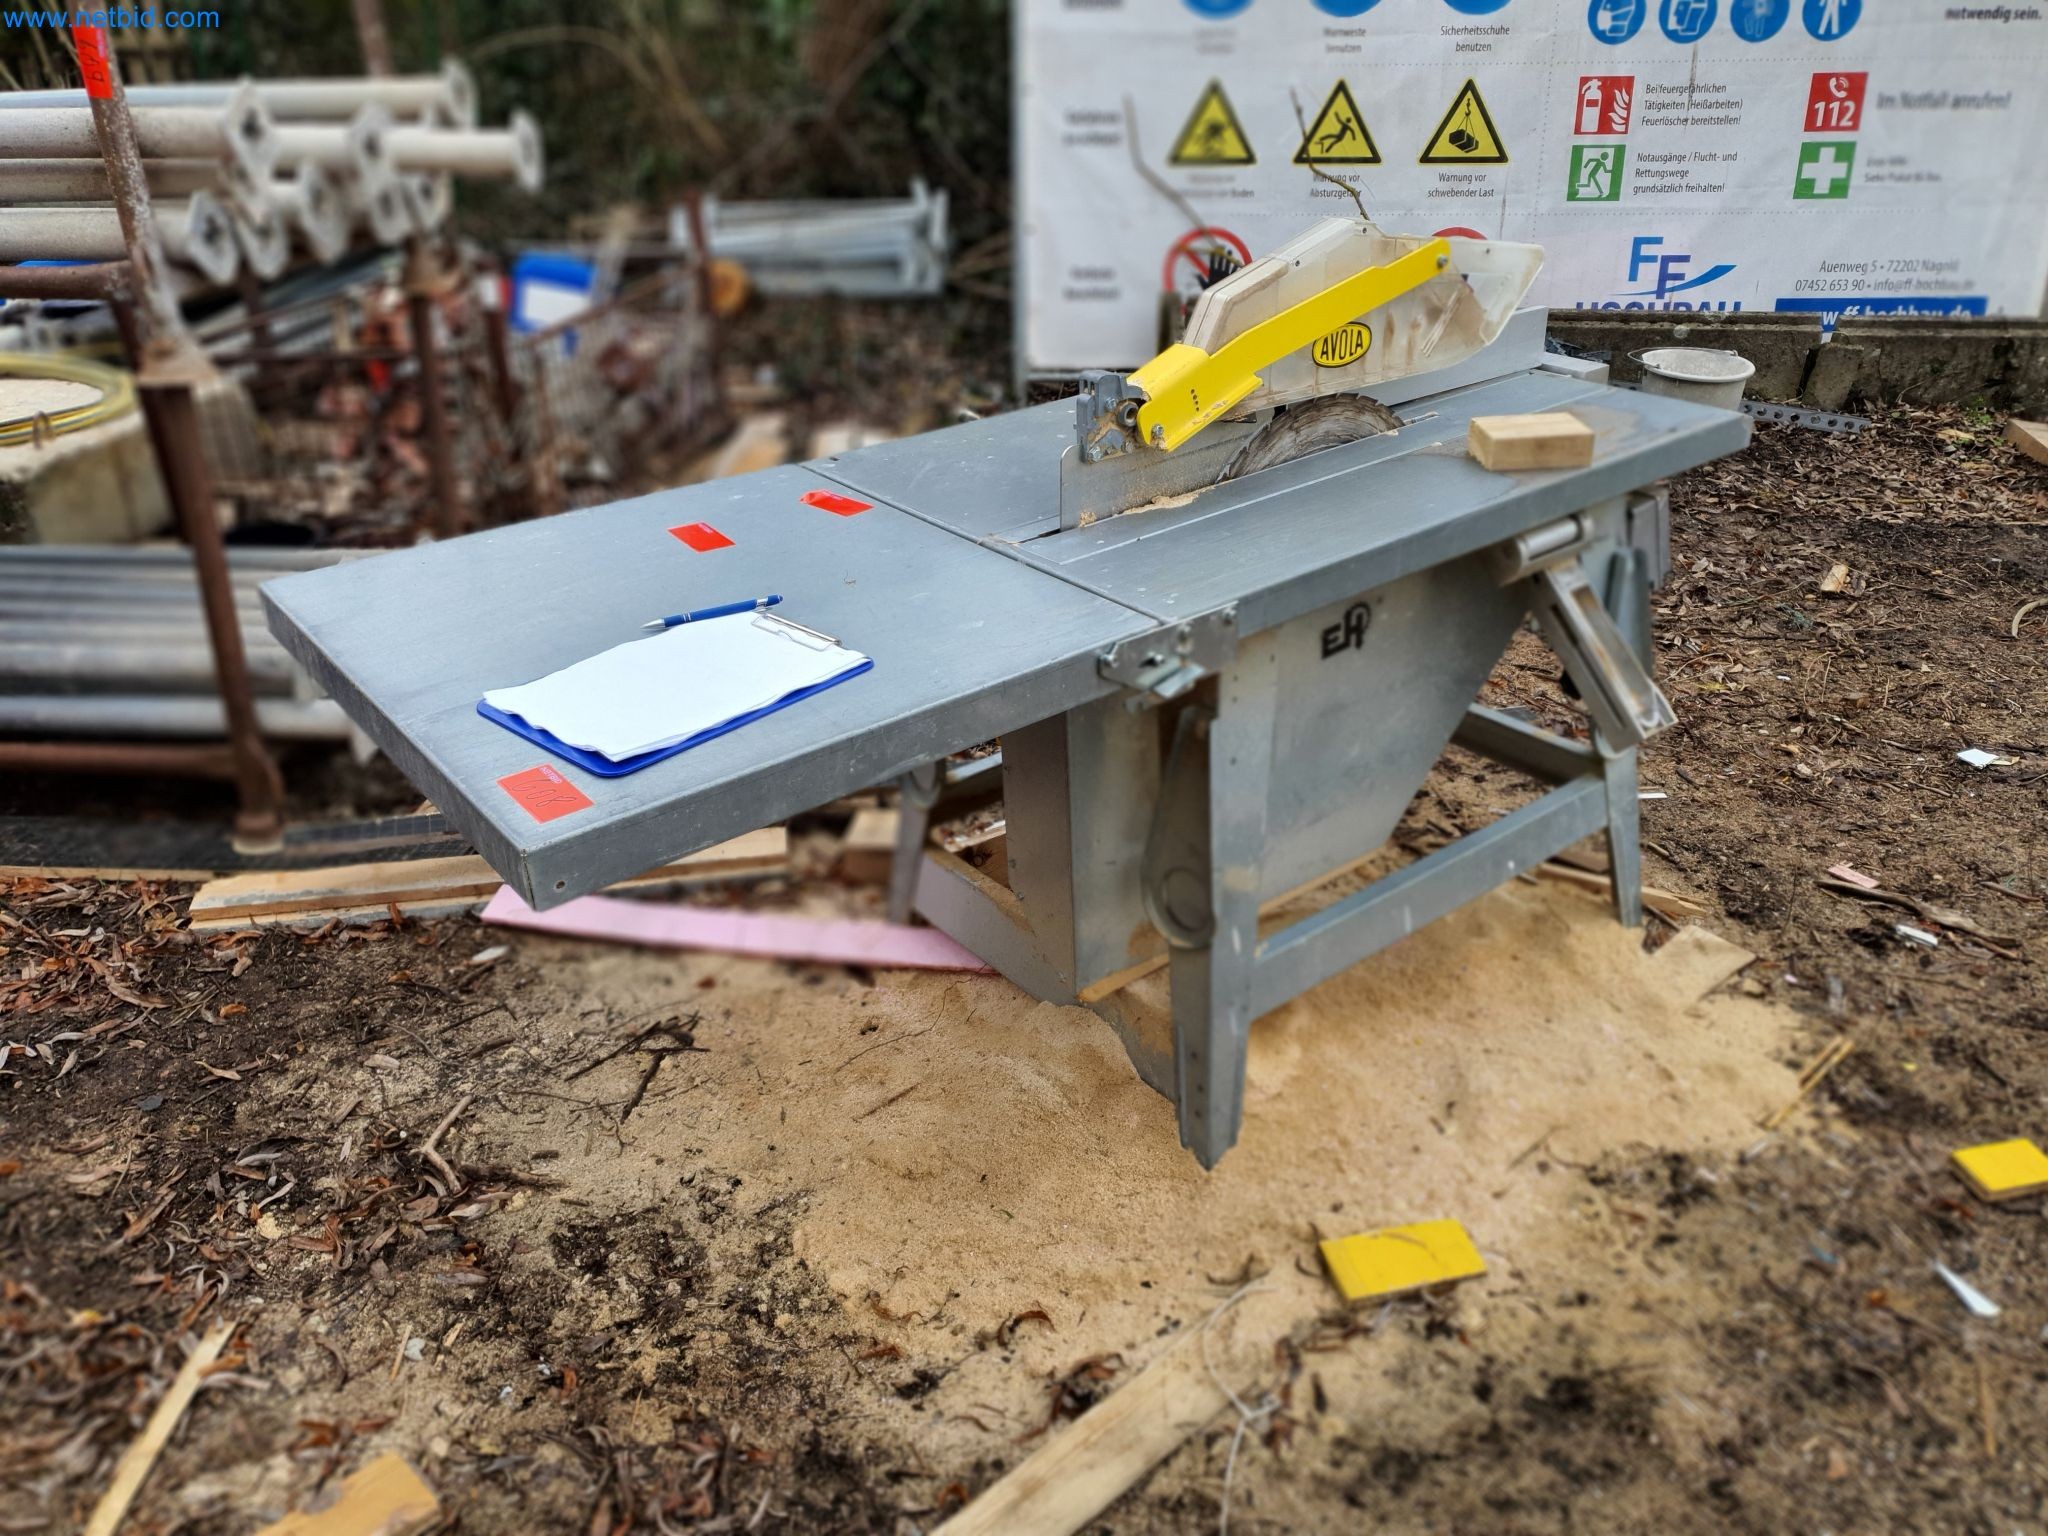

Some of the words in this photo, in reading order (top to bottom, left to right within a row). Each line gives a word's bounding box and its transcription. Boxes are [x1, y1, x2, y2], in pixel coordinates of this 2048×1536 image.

[2014, 5, 2043, 21] sein.
[1440, 24, 1510, 36] Sicherheitsschuhe
[1455, 41, 1492, 52] benutzen
[1645, 83, 1658, 94] Bei
[1659, 83, 1727, 97] feuergefährlichen
[1644, 100, 1686, 113] Tätigkeiten
[1687, 99, 1743, 112] (Heißarbeiten)
[1641, 115, 1689, 127] Feuerlöscher
[1690, 115, 1742, 126] bereitstellen!
[1814, 100, 1856, 128] 112
[1637, 152, 1687, 165] Notausgänge
[1694, 151, 1721, 162] Flucht-
[1722, 151, 1738, 162] und
[1348, 174, 1361, 183] vor
[1438, 172, 1473, 185] Warnung
[1474, 174, 1487, 182] vor
[1635, 167, 1690, 180] Rettungswege
[1428, 187, 1478, 198] schwebender
[1478, 187, 1495, 198] Last
[1633, 183, 1684, 196] grundsätzlich
[1684, 182, 1725, 193] freihalten!
[1818, 259, 1869, 276] Auenweg
[1870, 259, 1879, 273] 5
[1887, 259, 1921, 273] 72202
[1795, 279, 1828, 292] 07452
[1829, 278, 1850, 292] 653
[1851, 278, 1866, 291] 90
[1320, 327, 1364, 361] AVOLA
